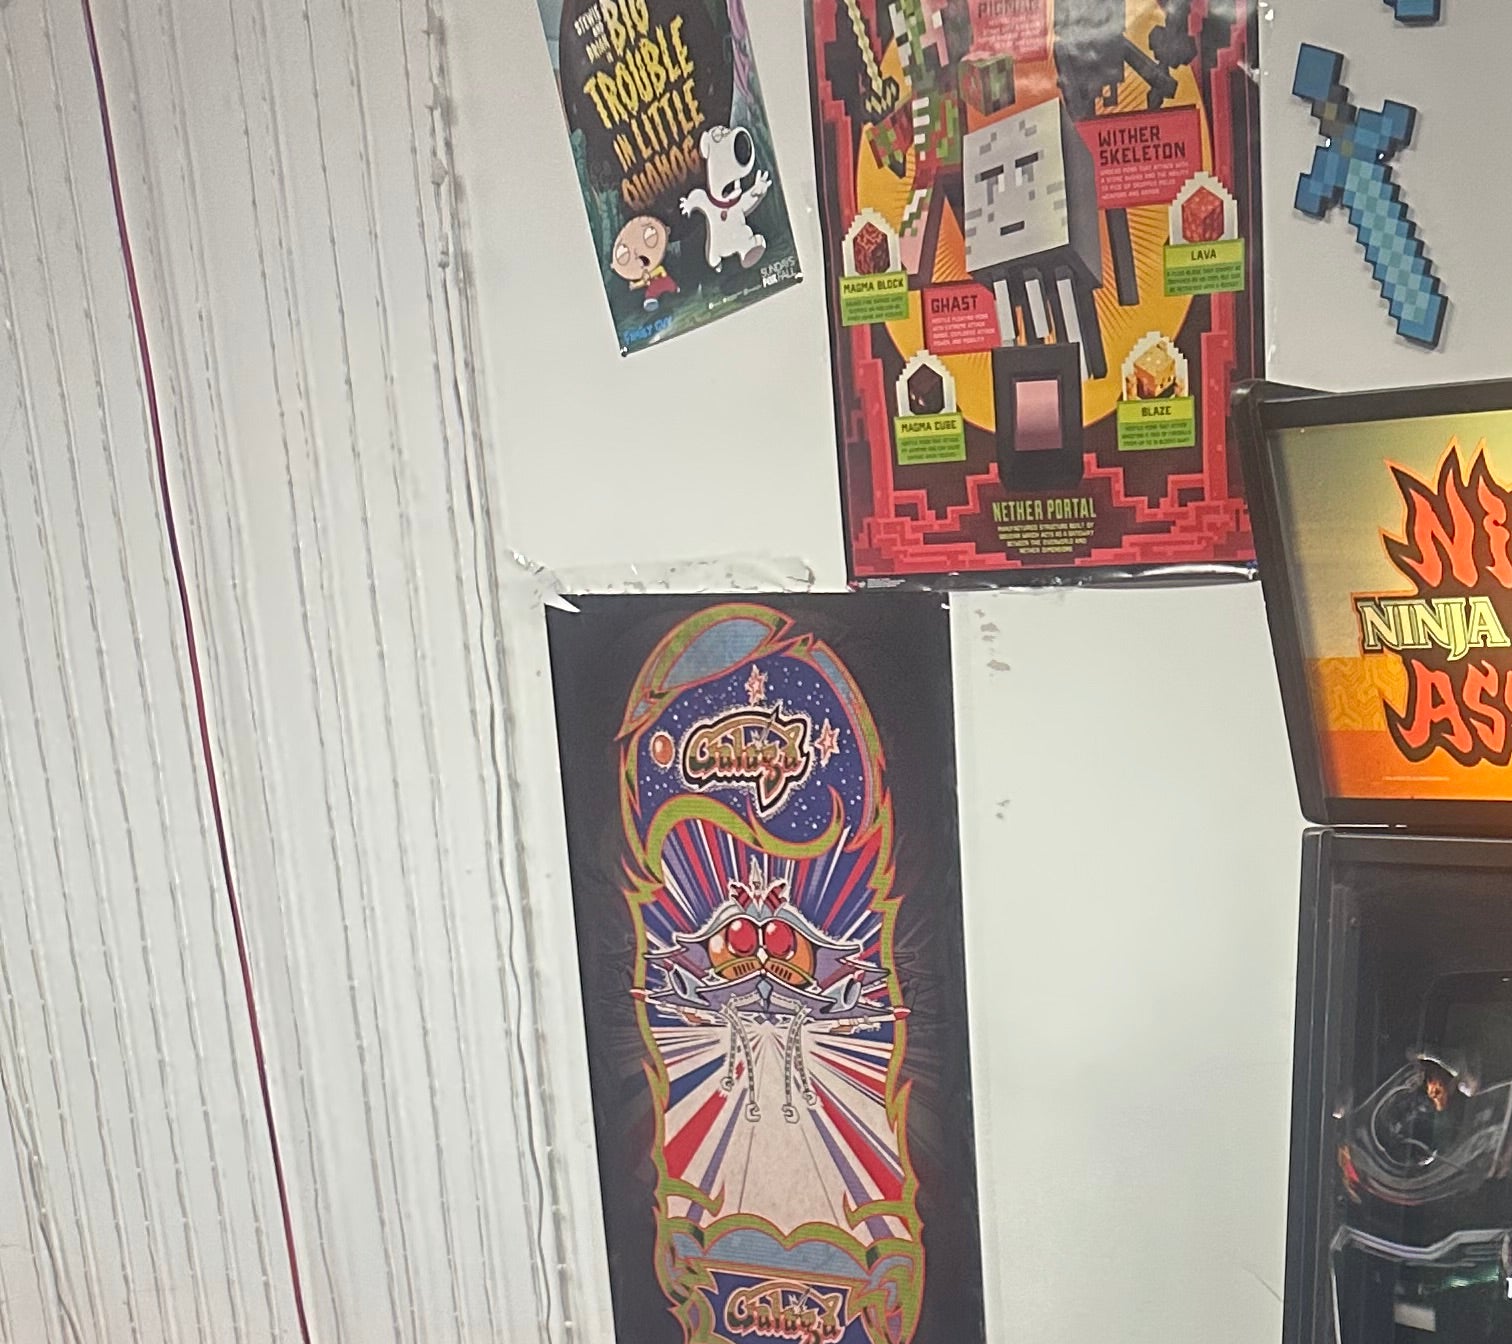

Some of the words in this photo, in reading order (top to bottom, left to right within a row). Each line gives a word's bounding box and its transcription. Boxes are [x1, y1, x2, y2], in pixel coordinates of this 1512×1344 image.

[599, 0, 649, 58] BIG
[583, 15, 694, 129] TROUBLE
[613, 133, 637, 173] IN
[631, 78, 705, 160] LITTLE
[1098, 125, 1161, 148] WITHER
[1100, 141, 1186, 166] SKELETON
[1191, 248, 1217, 261] LAVA
[843, 280, 875, 294] MAGMA
[931, 295, 978, 313] GHAST
[1141, 406, 1172, 417] BLAZE
[901, 421, 932, 432] MAGMA
[992, 501, 1043, 522] NETHER
[1047, 497, 1096, 520] PORTAL
[1358, 596, 1511, 661] NINJA
